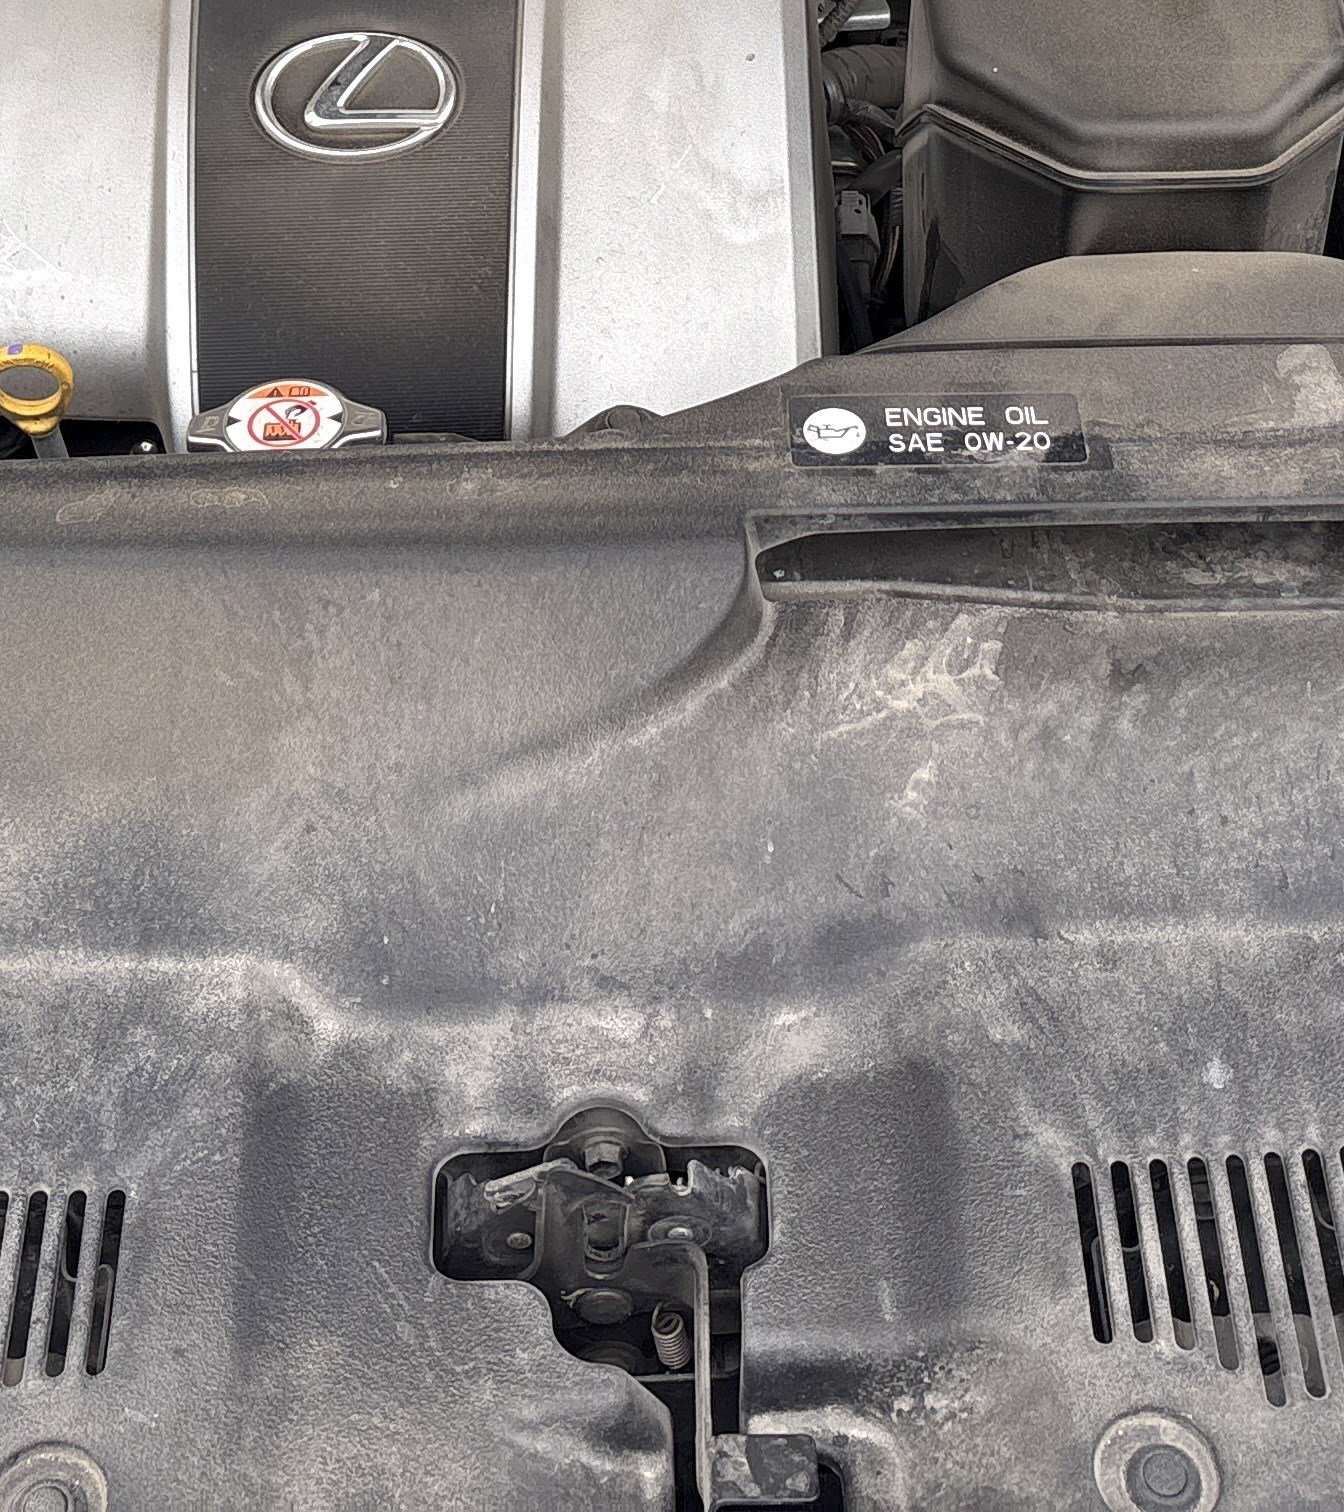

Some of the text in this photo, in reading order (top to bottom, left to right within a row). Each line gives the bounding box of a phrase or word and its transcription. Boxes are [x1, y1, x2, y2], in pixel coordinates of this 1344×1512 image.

[885, 405, 1049, 427] ENGINE OIL
[888, 431, 1051, 453] SAE 0W-20
